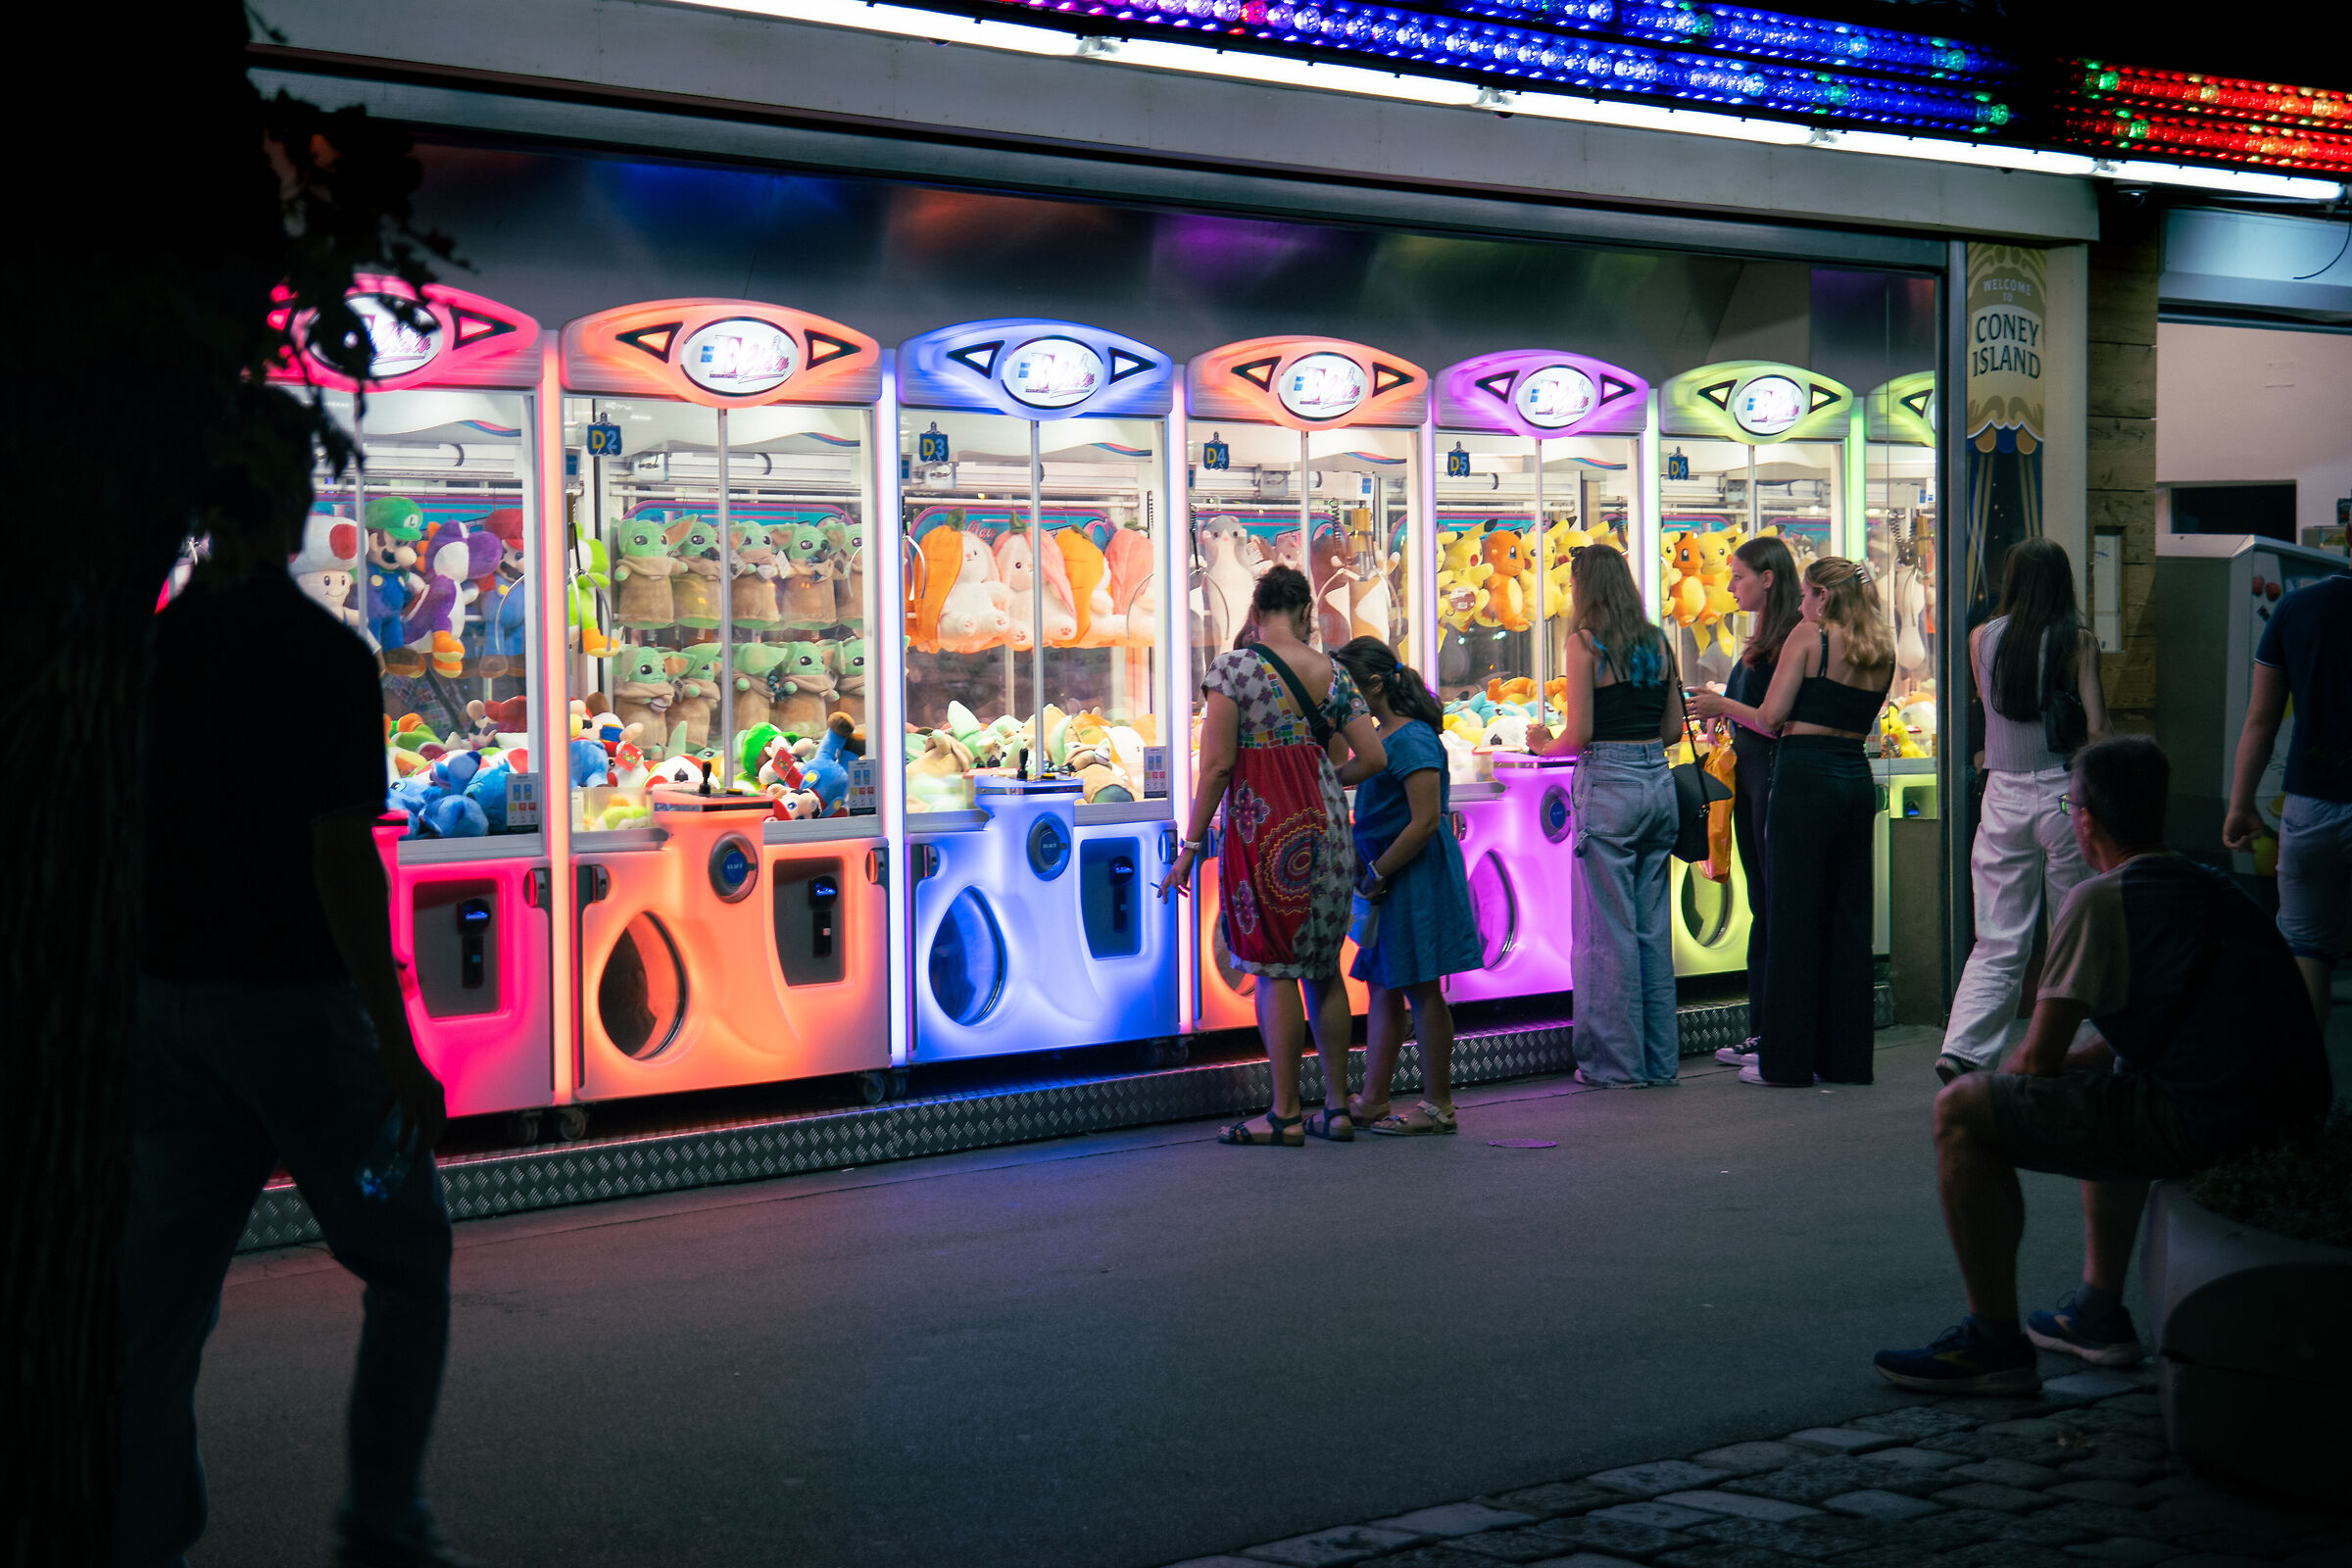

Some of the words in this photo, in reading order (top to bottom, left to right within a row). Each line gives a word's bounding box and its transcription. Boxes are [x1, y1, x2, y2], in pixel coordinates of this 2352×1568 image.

[1983, 278, 2032, 296] WELCOME
[2002, 294, 2013, 303] TO
[1976, 314, 2039, 347] CONEY
[1972, 345, 2041, 379] ISLAND
[592, 429, 617, 450] D2
[922, 438, 945, 457] D3
[1206, 447, 1226, 465] D4
[1449, 456, 1467, 472] D5
[1671, 461, 1687, 475] D6
[410, 516, 416, 526] L
